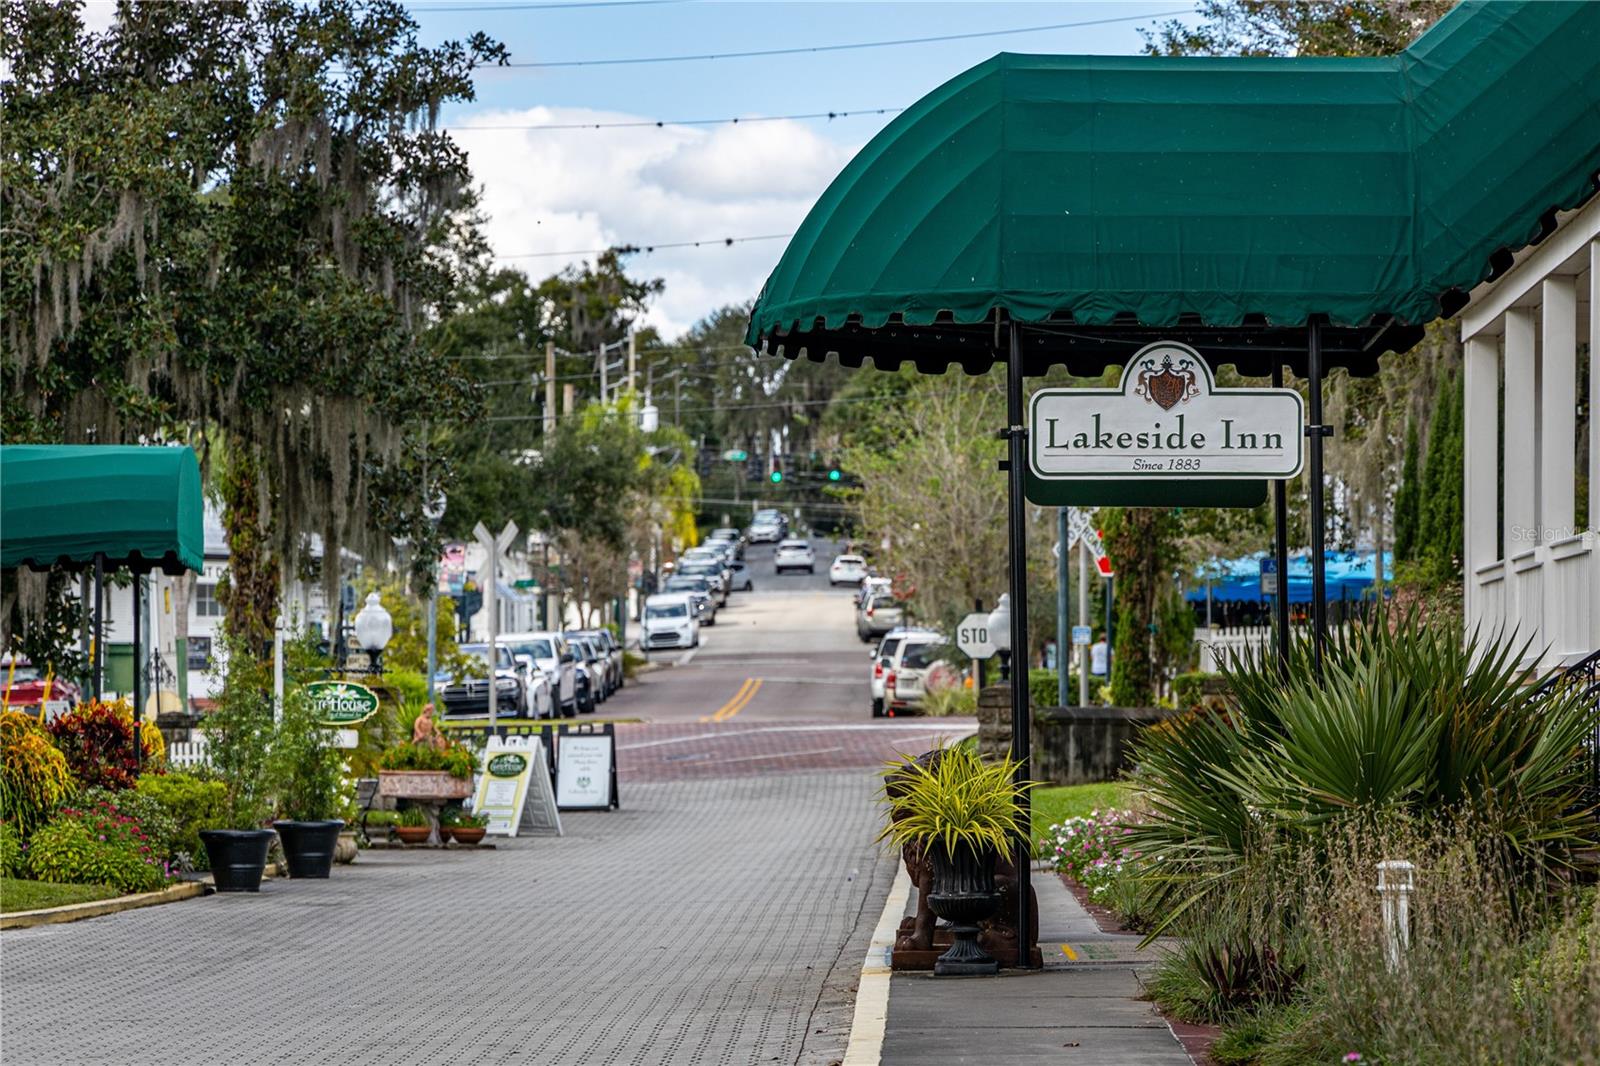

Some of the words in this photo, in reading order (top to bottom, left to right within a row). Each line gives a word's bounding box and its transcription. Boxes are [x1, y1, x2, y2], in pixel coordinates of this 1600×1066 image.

[1045, 413, 1206, 451] Lakeside
[1220, 419, 1284, 450] Inn
[1132, 458, 1163, 471] Since
[1168, 458, 1201, 471] 1883
[961, 627, 988, 645] STO
